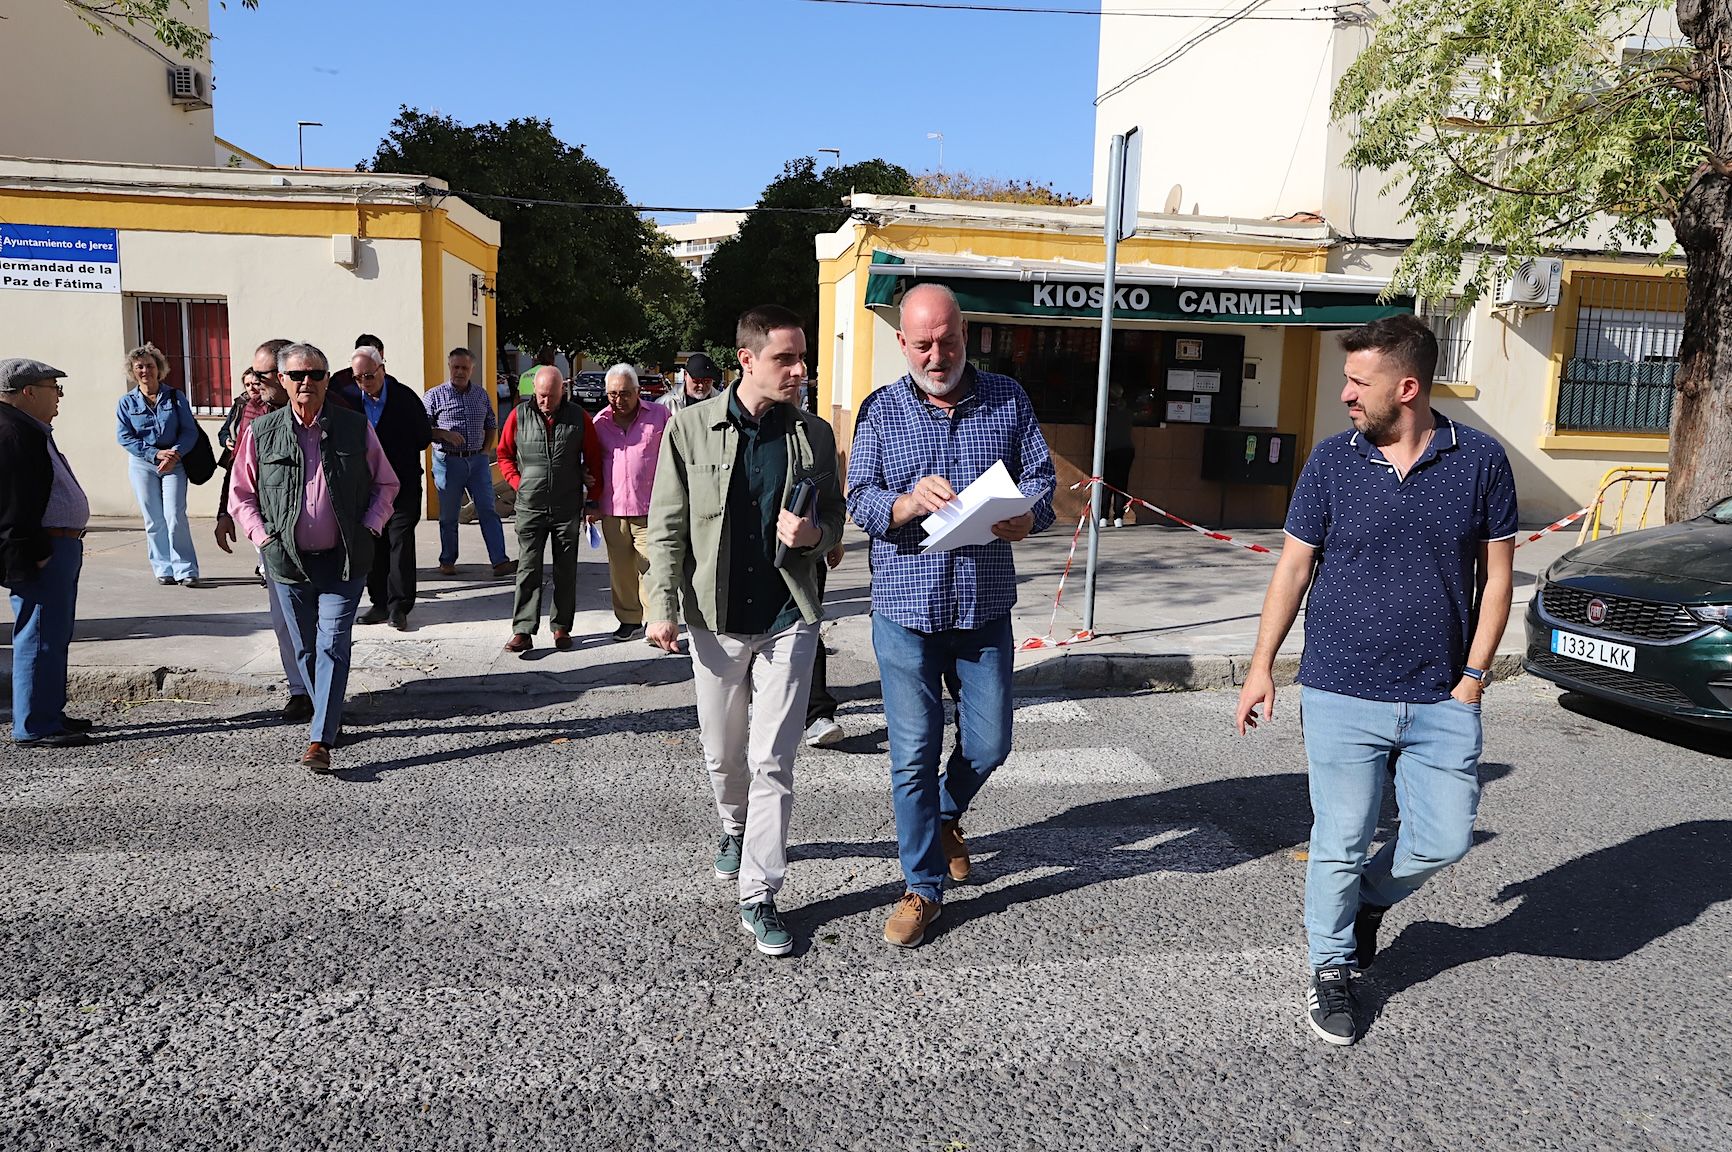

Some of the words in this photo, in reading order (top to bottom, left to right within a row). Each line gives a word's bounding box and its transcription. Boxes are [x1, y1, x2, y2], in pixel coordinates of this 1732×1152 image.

[3, 236, 73, 249] Ayuntamiento
[75, 240, 87, 249] de
[89, 240, 114, 251] Jerez
[0, 260, 74, 273] ermandad
[78, 264, 95, 274] de
[100, 264, 112, 275] la
[3, 276, 29, 287] Paz
[33, 277, 50, 287] de
[55, 278, 103, 289] Fátima
[1033, 284, 1150, 310] KIOSKO
[1178, 290, 1303, 316] CARMEN
[1562, 635, 1596, 660] 1332
[1600, 644, 1630, 668] LKK
